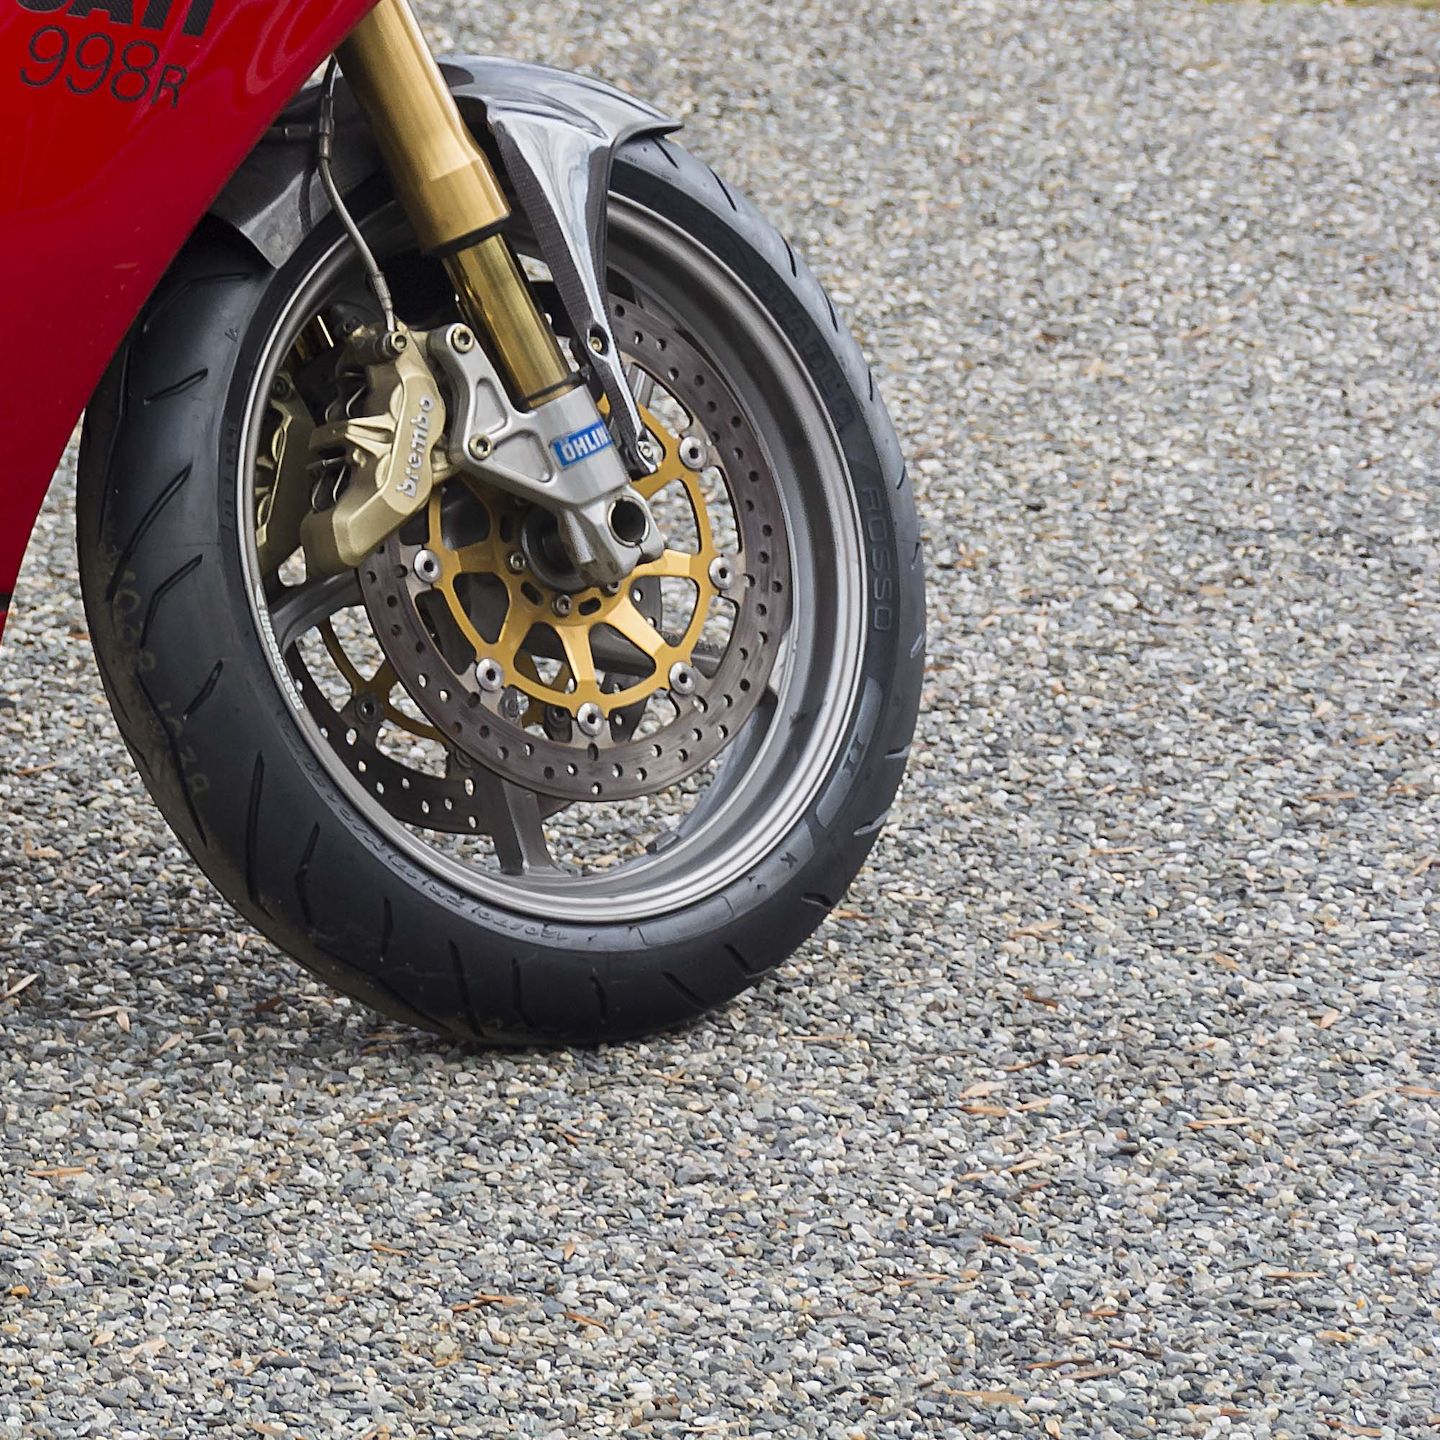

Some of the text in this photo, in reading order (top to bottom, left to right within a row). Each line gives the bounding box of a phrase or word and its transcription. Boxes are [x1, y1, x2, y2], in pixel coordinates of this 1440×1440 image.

[19, 25, 188, 109] 998R
[395, 394, 435, 498] brembo
[858, 483, 895, 634] ROSSO
